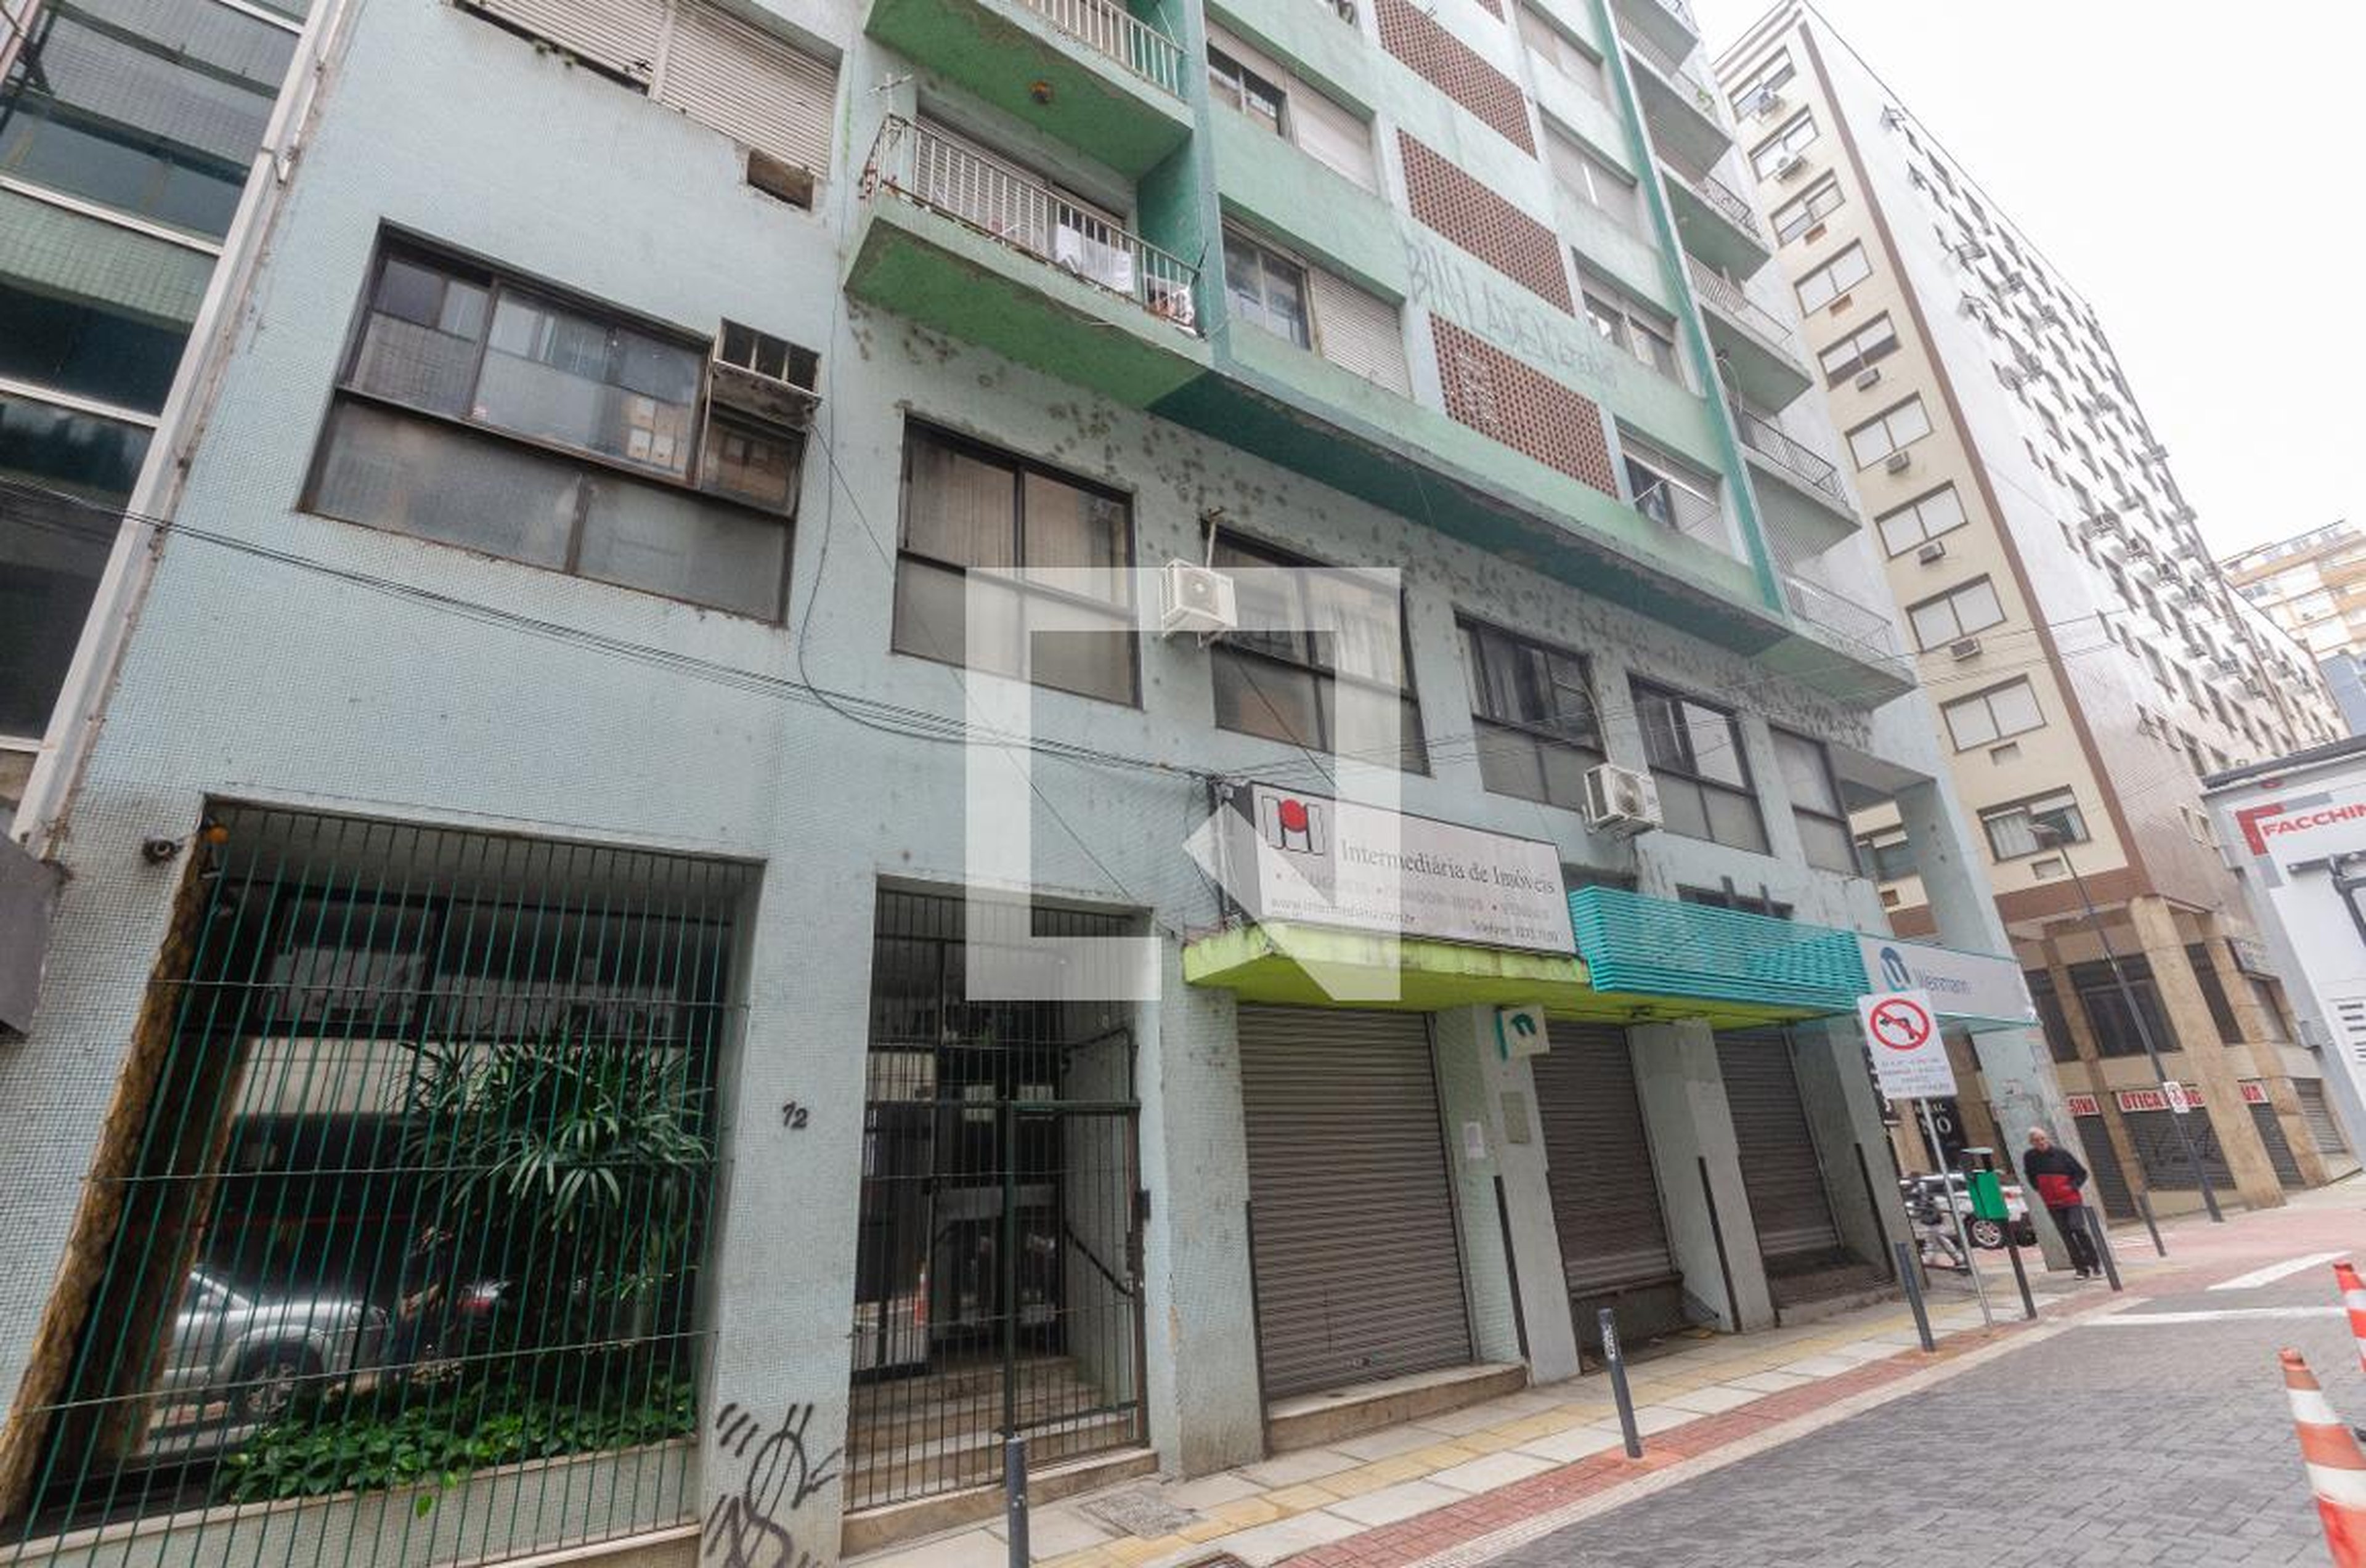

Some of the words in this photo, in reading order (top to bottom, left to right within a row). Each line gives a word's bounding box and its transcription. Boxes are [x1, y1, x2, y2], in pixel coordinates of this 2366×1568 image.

[1342, 840, 1465, 880] Intermediária
[1470, 863, 1488, 883] de
[1493, 866, 1555, 894] Imóveis
[783, 1101, 807, 1130] 12
